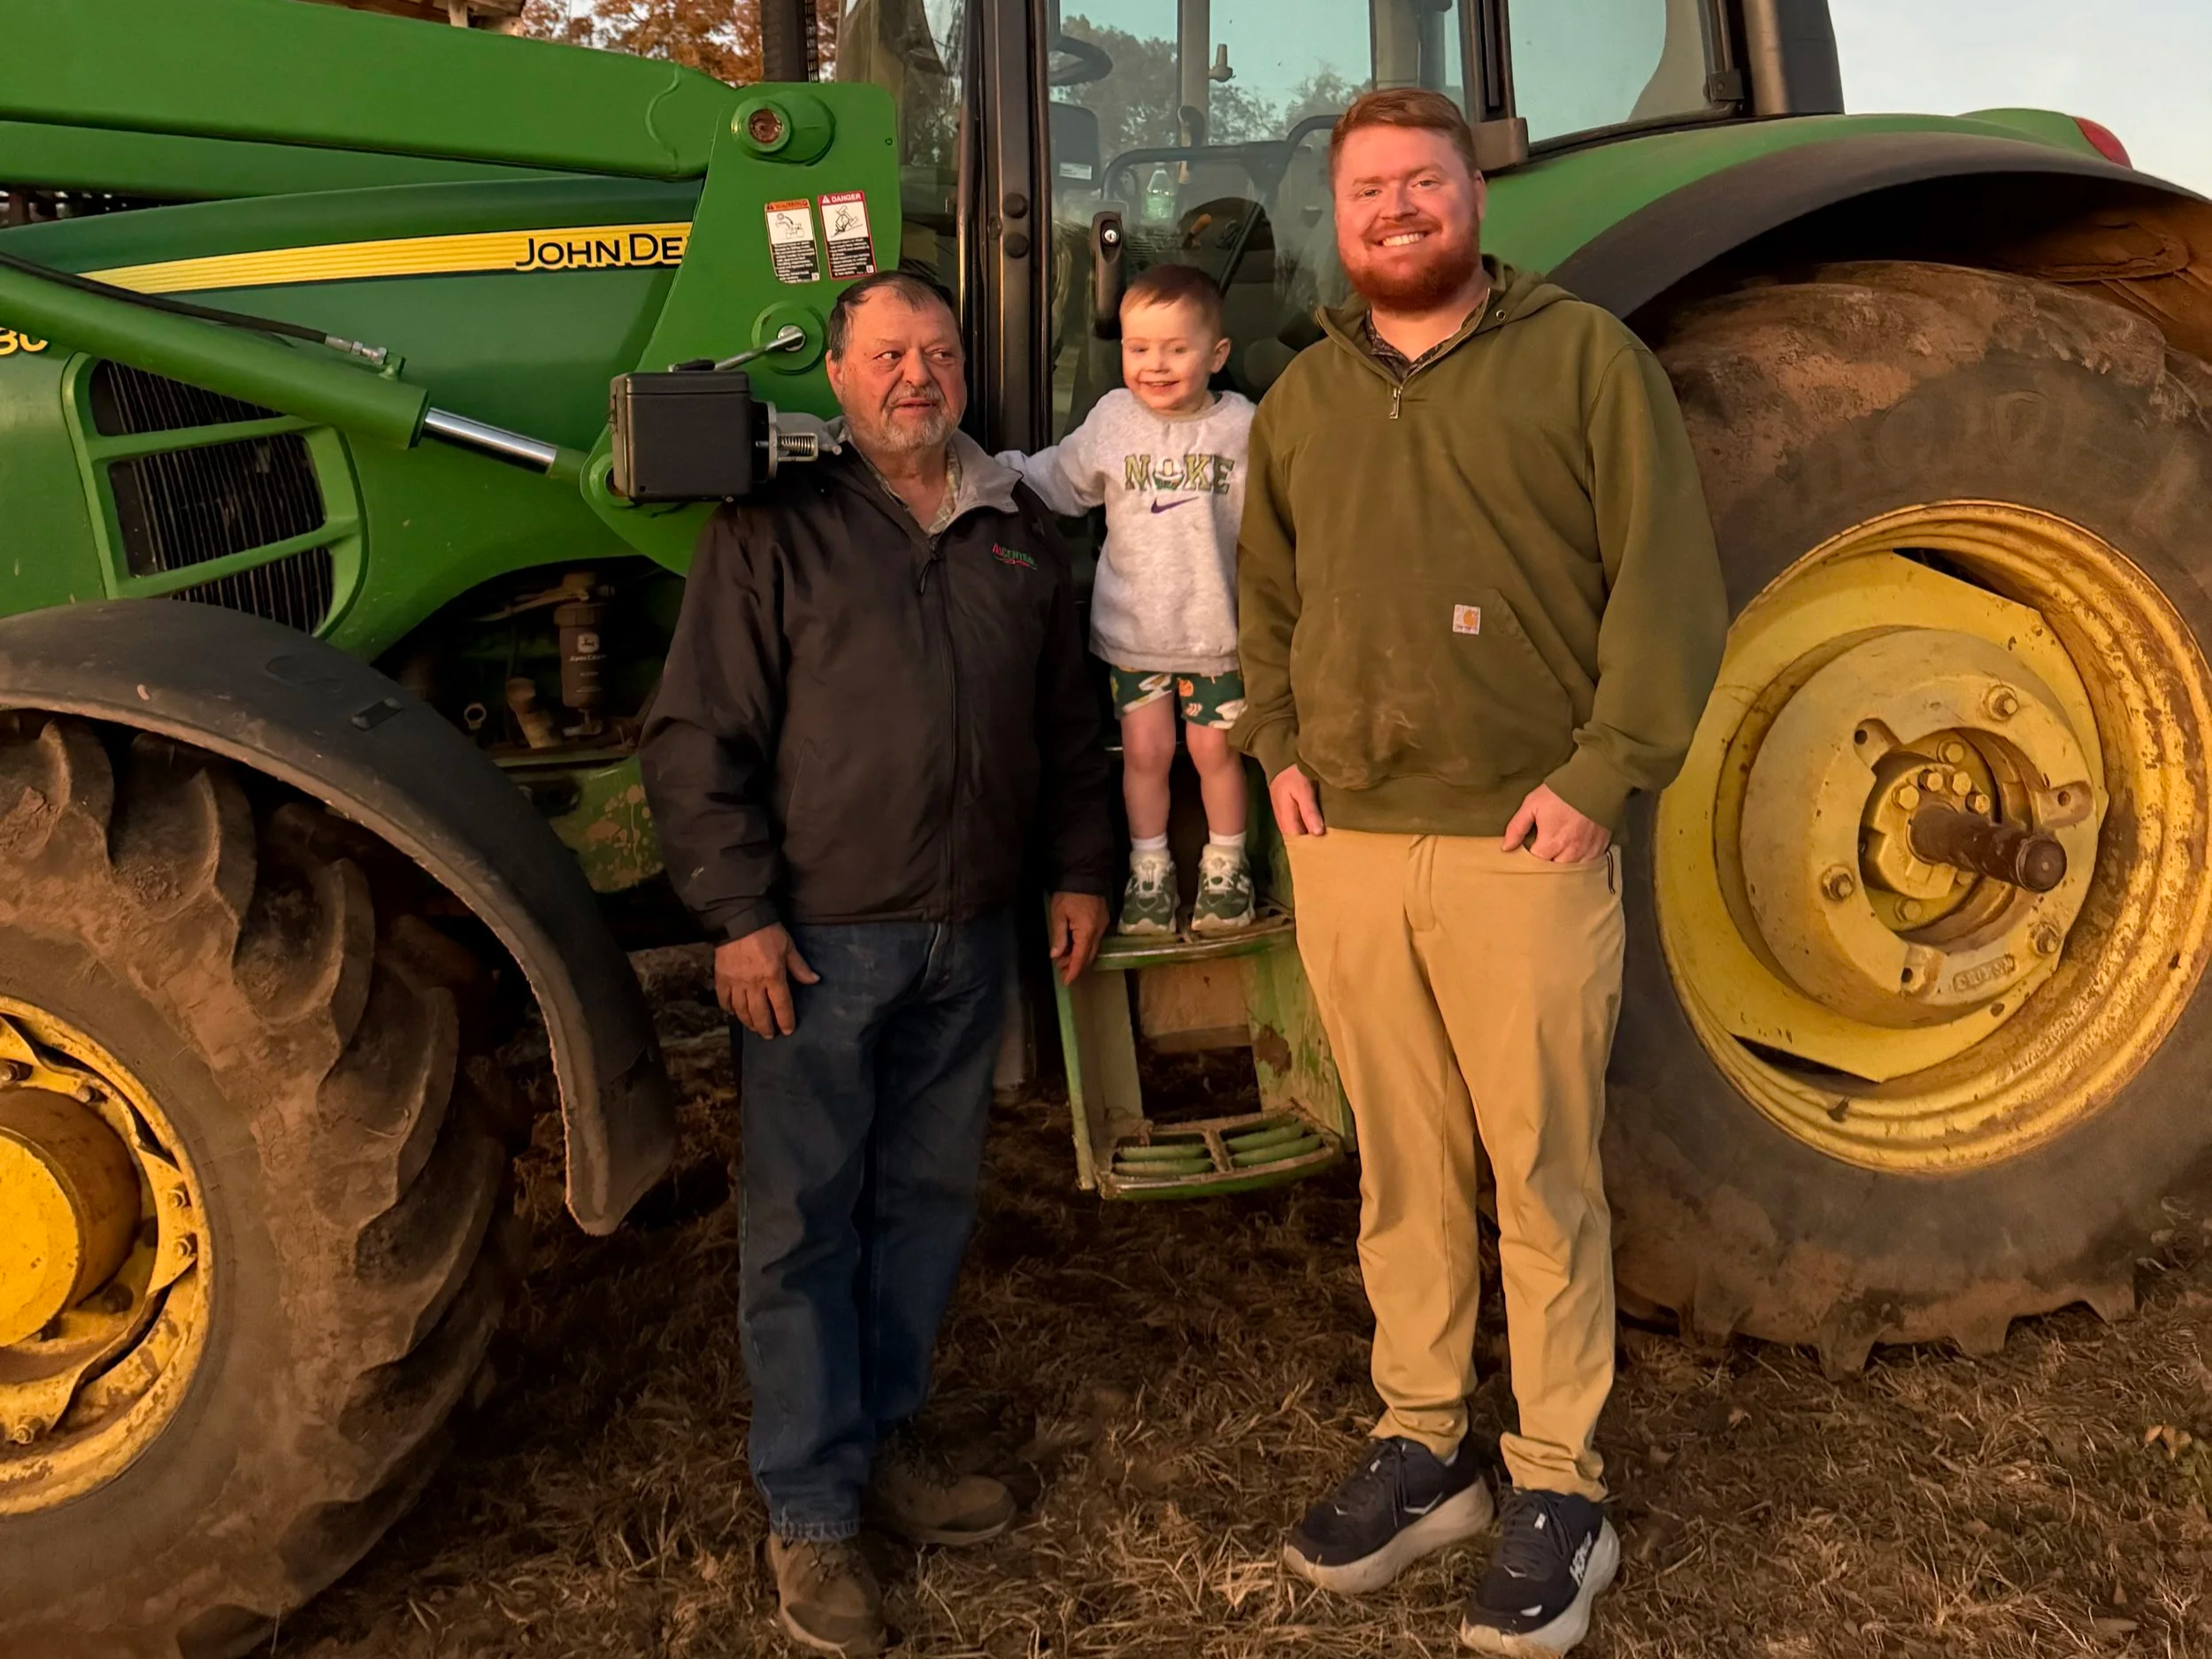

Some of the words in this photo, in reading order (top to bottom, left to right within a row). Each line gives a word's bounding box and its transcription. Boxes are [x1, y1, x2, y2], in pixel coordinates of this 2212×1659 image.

[831, 193, 861, 203] DANGER
[516, 237, 620, 266] JOHN
[629, 233, 685, 262] DE
